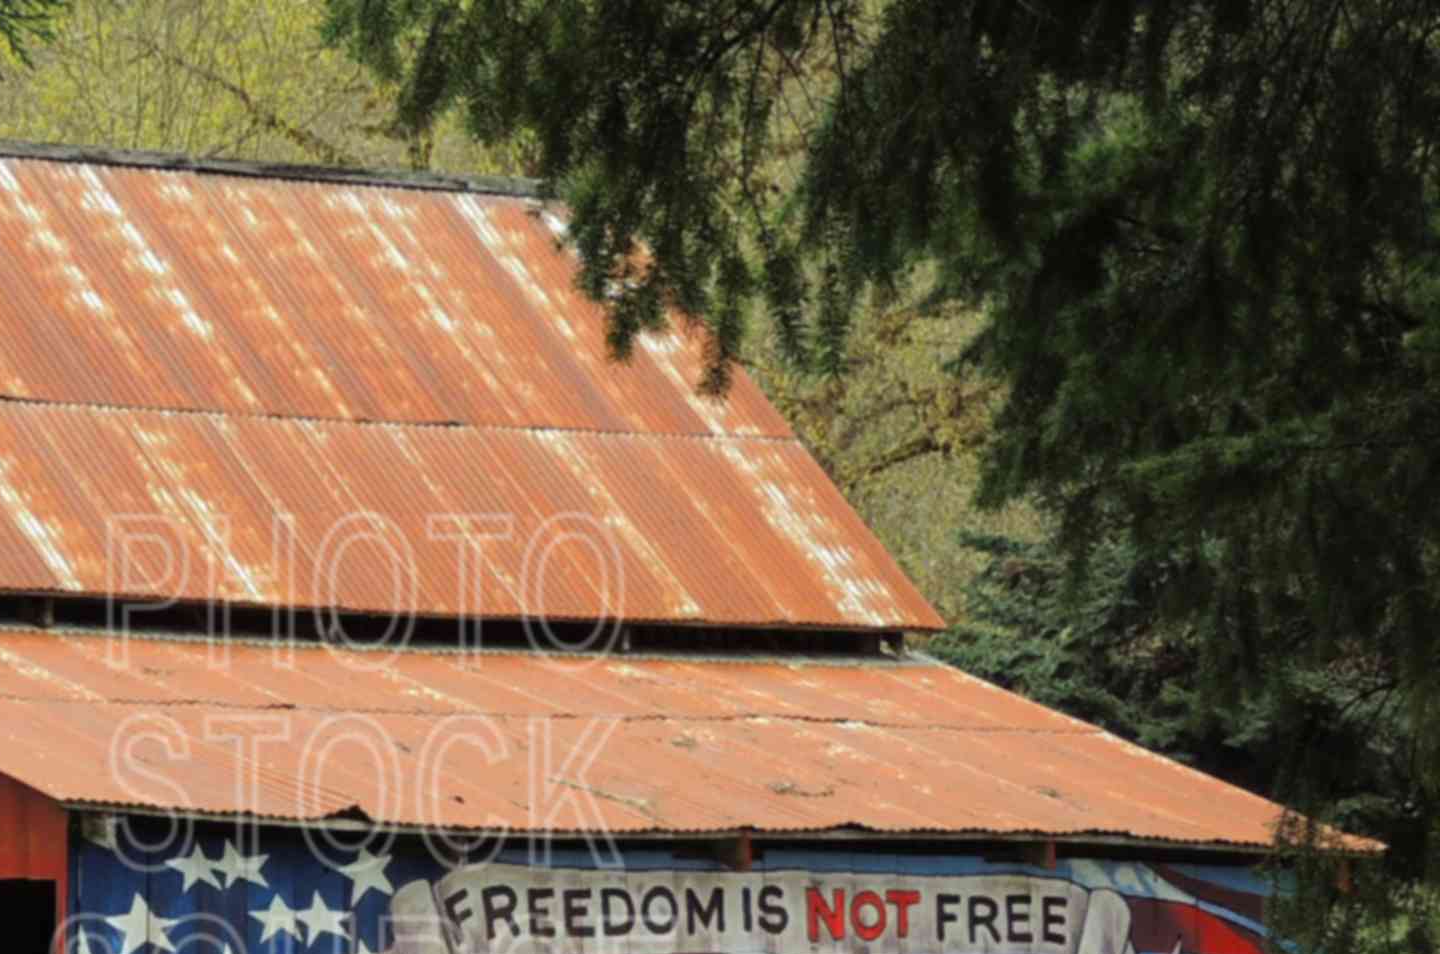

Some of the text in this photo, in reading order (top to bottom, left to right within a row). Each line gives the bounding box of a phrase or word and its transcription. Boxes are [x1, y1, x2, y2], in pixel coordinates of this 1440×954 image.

[446, 885, 1067, 946] FREEDOM IS NOT FREE
